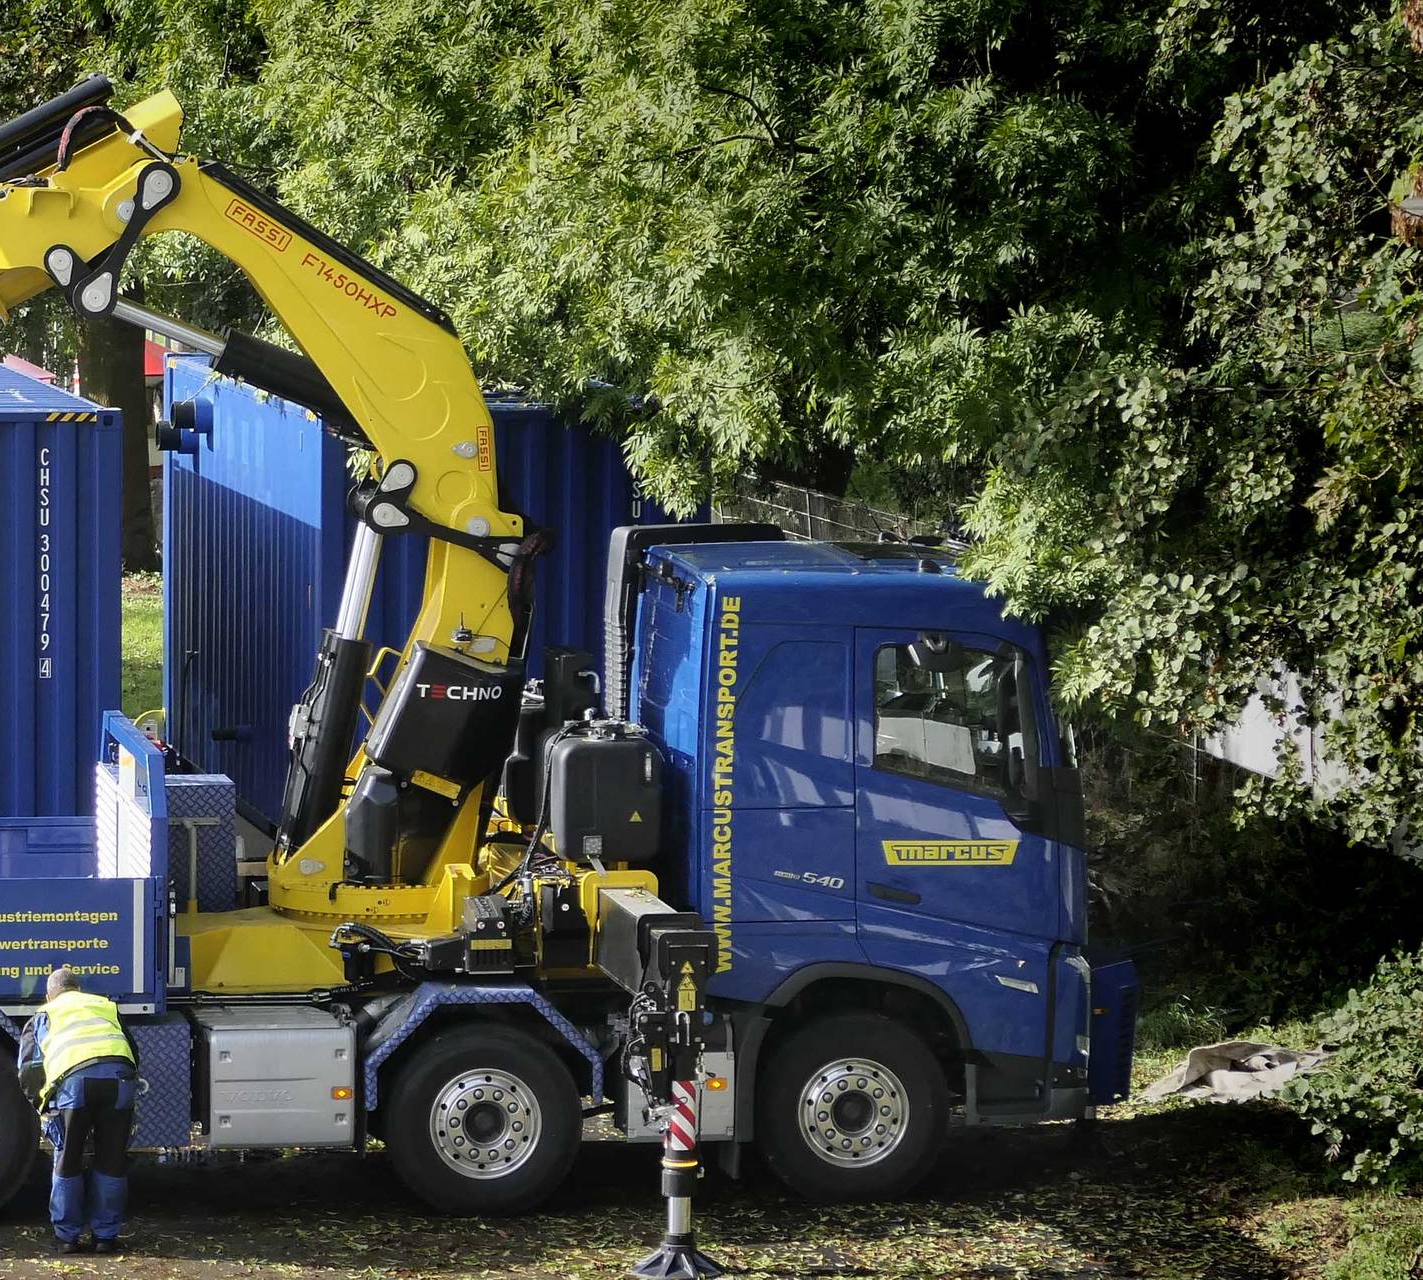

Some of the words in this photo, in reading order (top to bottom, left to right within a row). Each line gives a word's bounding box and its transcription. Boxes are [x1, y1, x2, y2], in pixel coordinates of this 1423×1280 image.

[231, 205, 286, 246] FASSI
[300, 252, 398, 319] F1450HXP
[478, 429, 489, 468] FASSI
[40, 448, 50, 527] CHSU
[40, 534, 50, 651] 300479
[41, 659, 50, 678] 4
[415, 682, 503, 701] TECHNO
[712, 596, 741, 973] WWW.MARCUSTRANSPORT.DE
[892, 845, 1010, 861] marcus
[802, 872, 844, 889] 540
[24, 964, 52, 976] und
